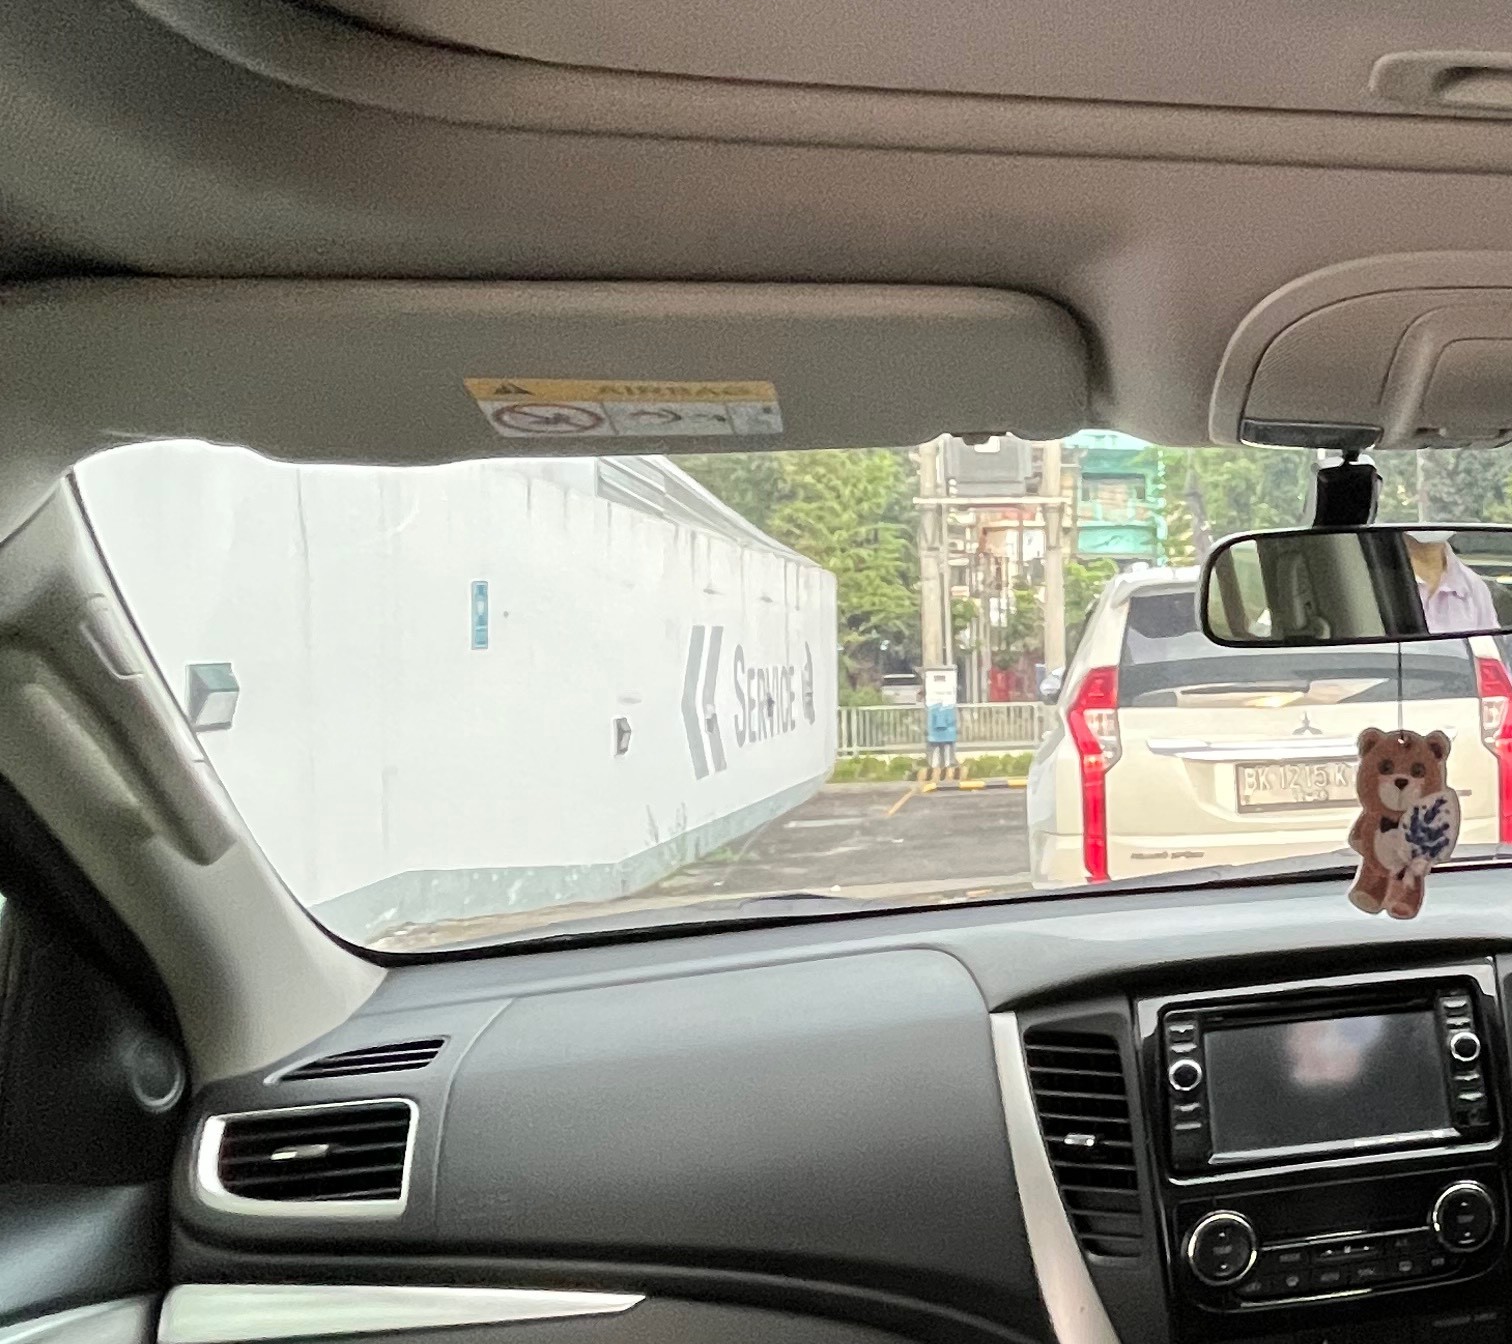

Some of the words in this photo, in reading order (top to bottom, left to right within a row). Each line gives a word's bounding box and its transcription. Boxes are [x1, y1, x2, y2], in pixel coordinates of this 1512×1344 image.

[733, 643, 796, 748] SERVICE
[1243, 766, 1271, 792] BK
[1279, 764, 1330, 789] 1215
